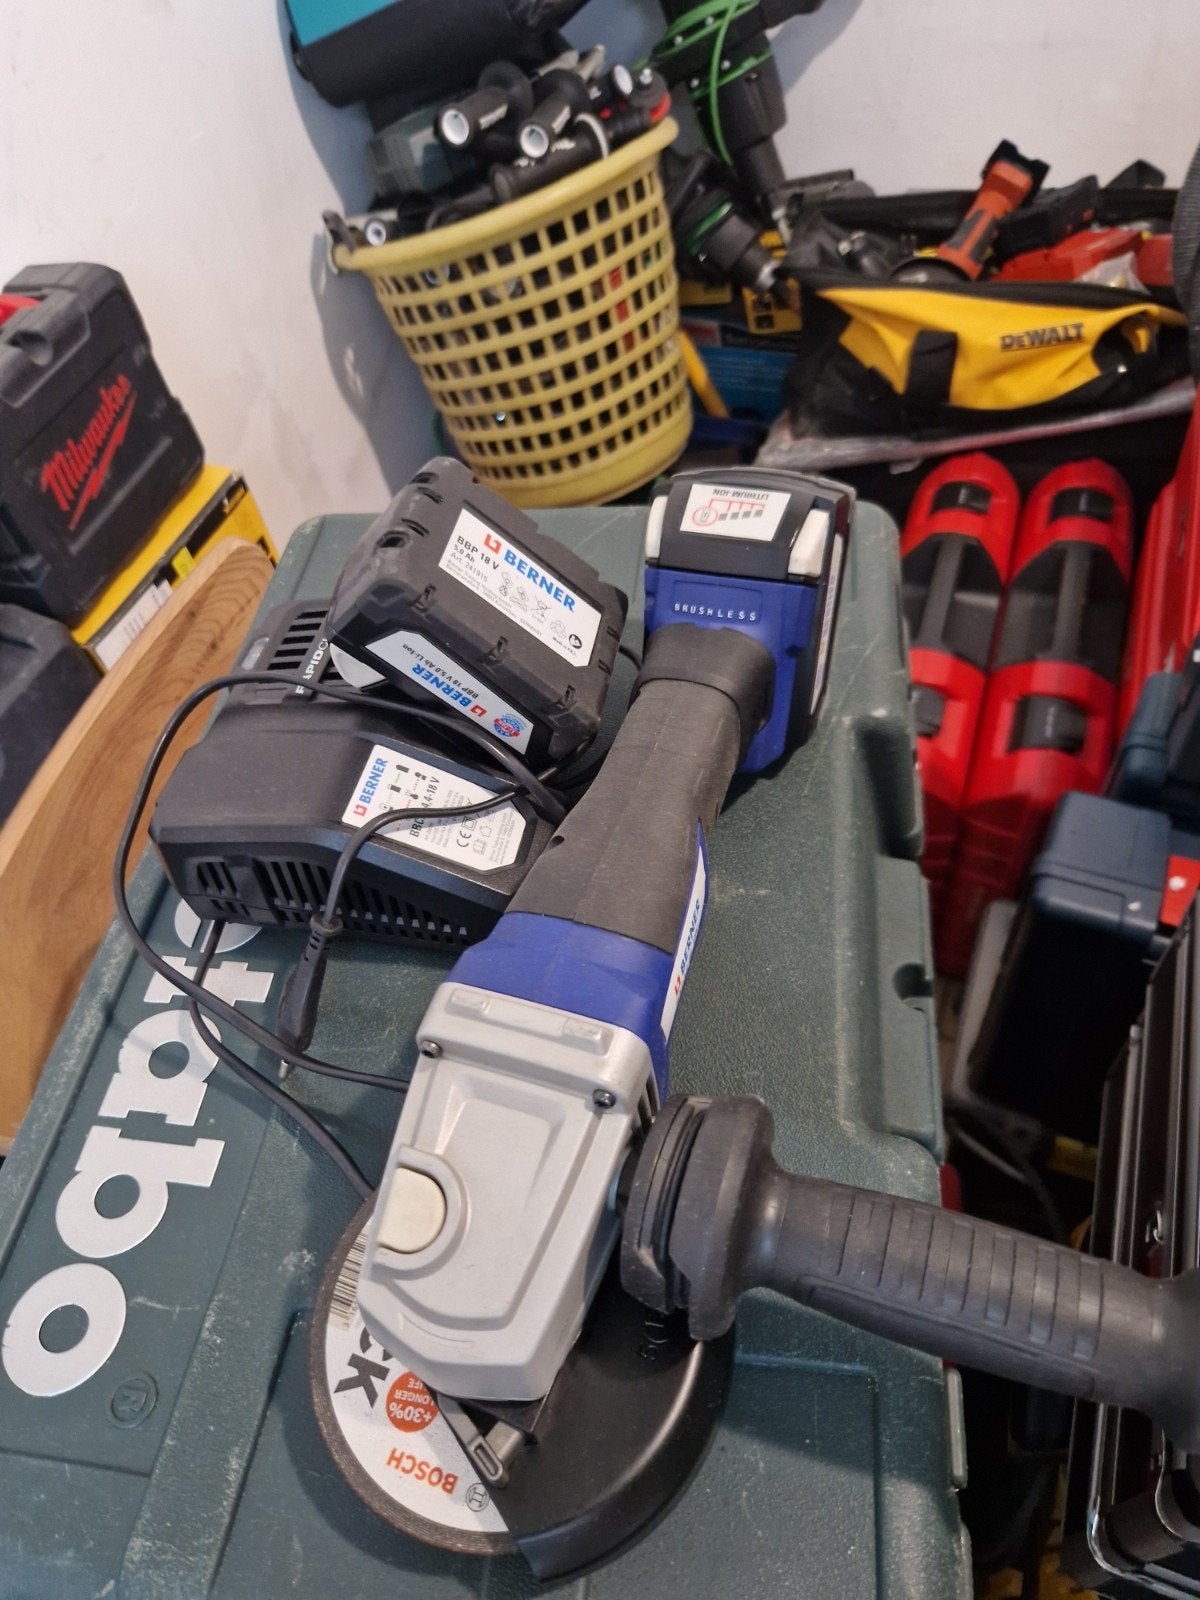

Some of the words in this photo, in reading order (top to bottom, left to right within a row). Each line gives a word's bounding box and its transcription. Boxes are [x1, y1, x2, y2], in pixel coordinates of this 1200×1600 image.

[456, 535, 478, 553] BBP
[480, 552, 491, 565] 18
[492, 561, 500, 570] V
[465, 552, 475, 563] Ah
[503, 549, 576, 613] BERNER
[674, 602, 757, 621] BRUSHLESS
[424, 660, 435, 669] Ah
[411, 663, 473, 708] BERNER
[452, 679, 462, 689] 18
[462, 686, 480, 700] BBP
[358, 757, 389, 805] BERNER
[421, 784, 438, 809] 4,4-18
[430, 776, 440, 784] V
[680, 899, 700, 975] BERNER
[1, 897, 276, 1397] tabo
[408, 1377, 424, 1390] IFE
[388, 1401, 433, 1425] +30%
[386, 1447, 460, 1495] BOSCH
